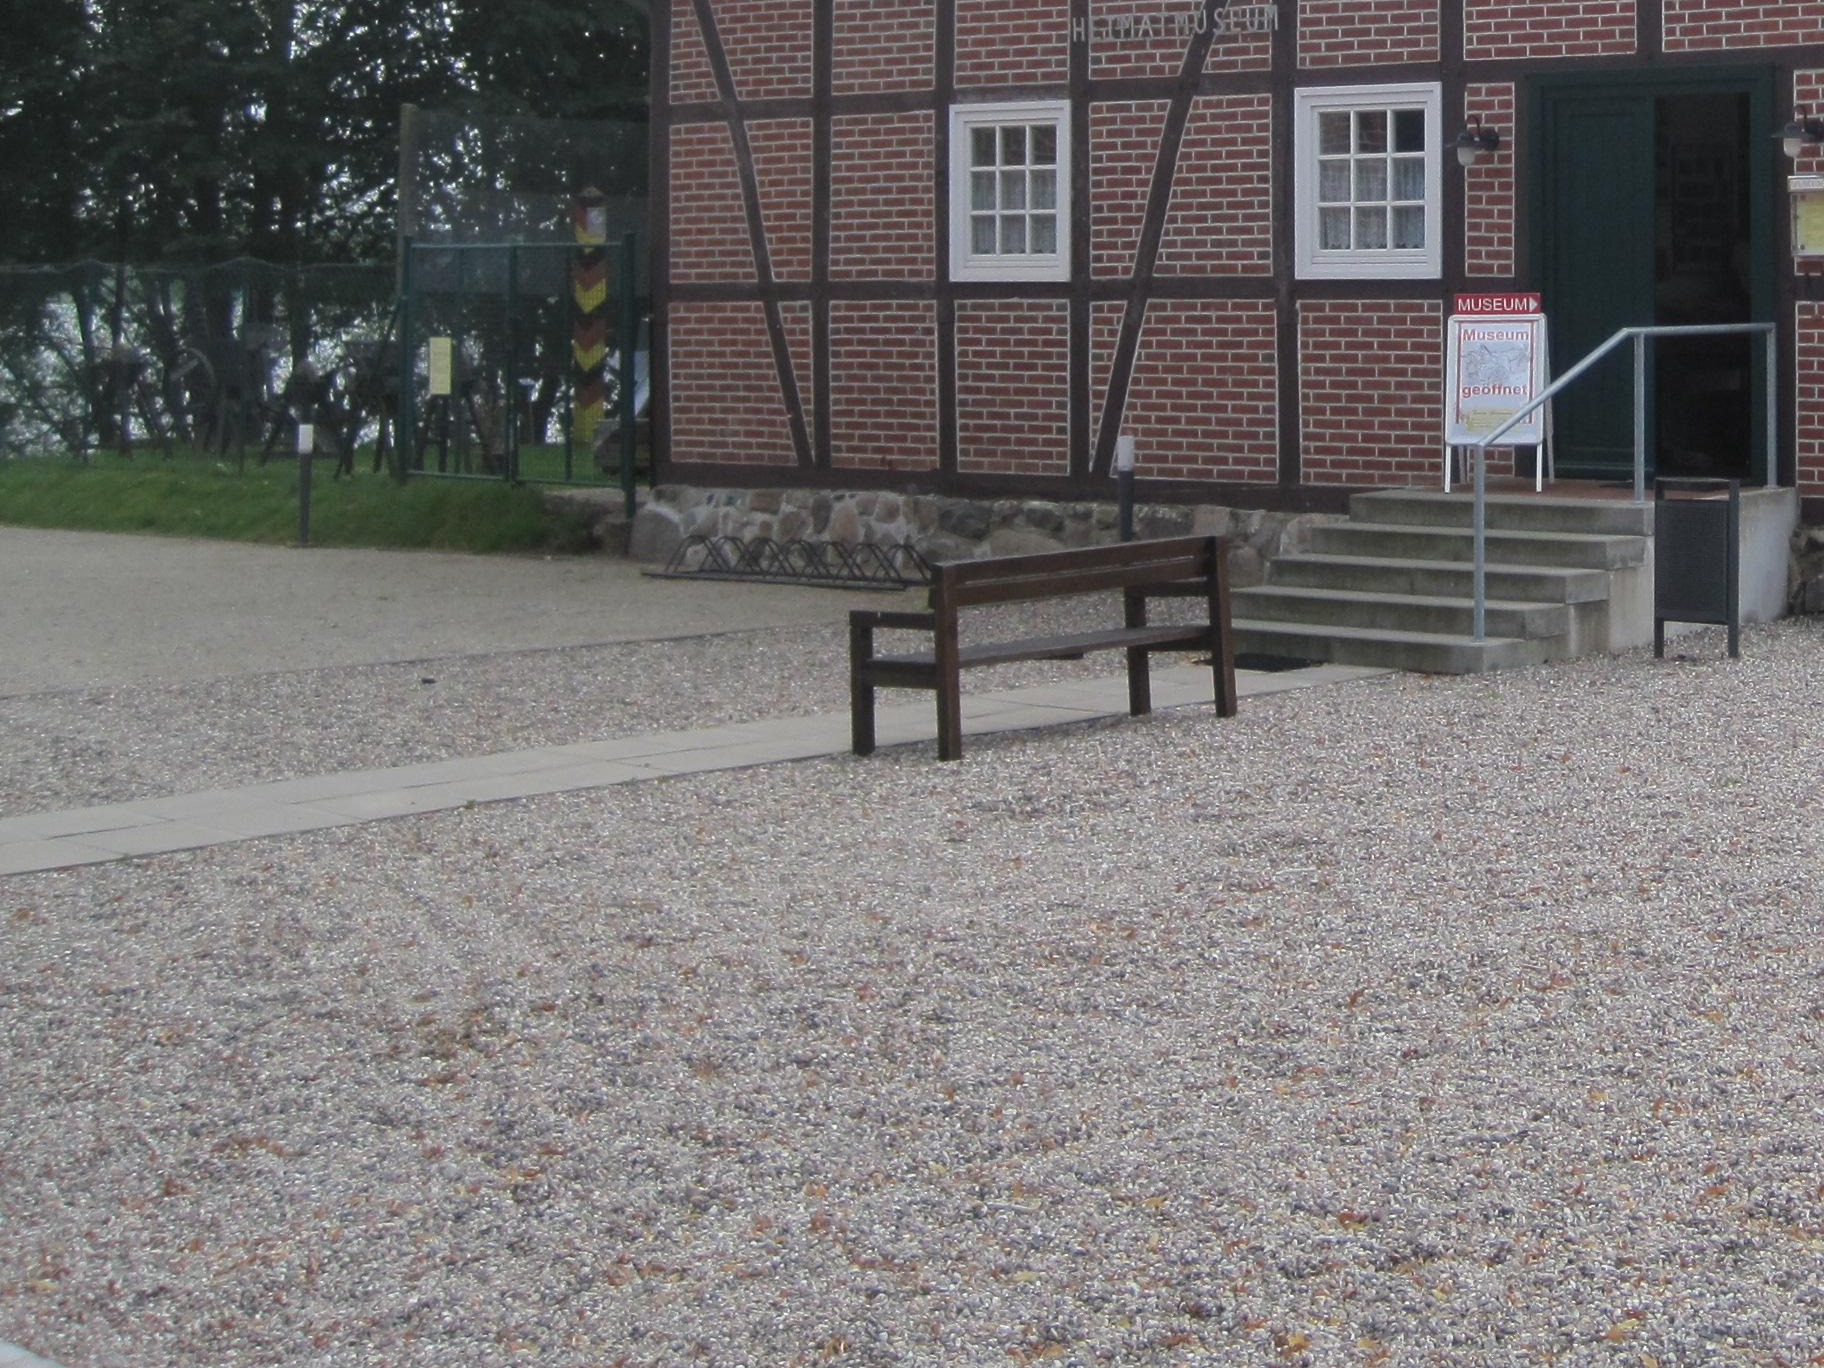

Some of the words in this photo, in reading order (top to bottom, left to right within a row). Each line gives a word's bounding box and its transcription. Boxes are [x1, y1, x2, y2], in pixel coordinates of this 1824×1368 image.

[1073, 5, 1278, 42] HEIMATMUSEUM
[1458, 298, 1527, 312] MUSEUM
[1463, 329, 1529, 342] Museum
[1462, 383, 1528, 398] geöffnet
